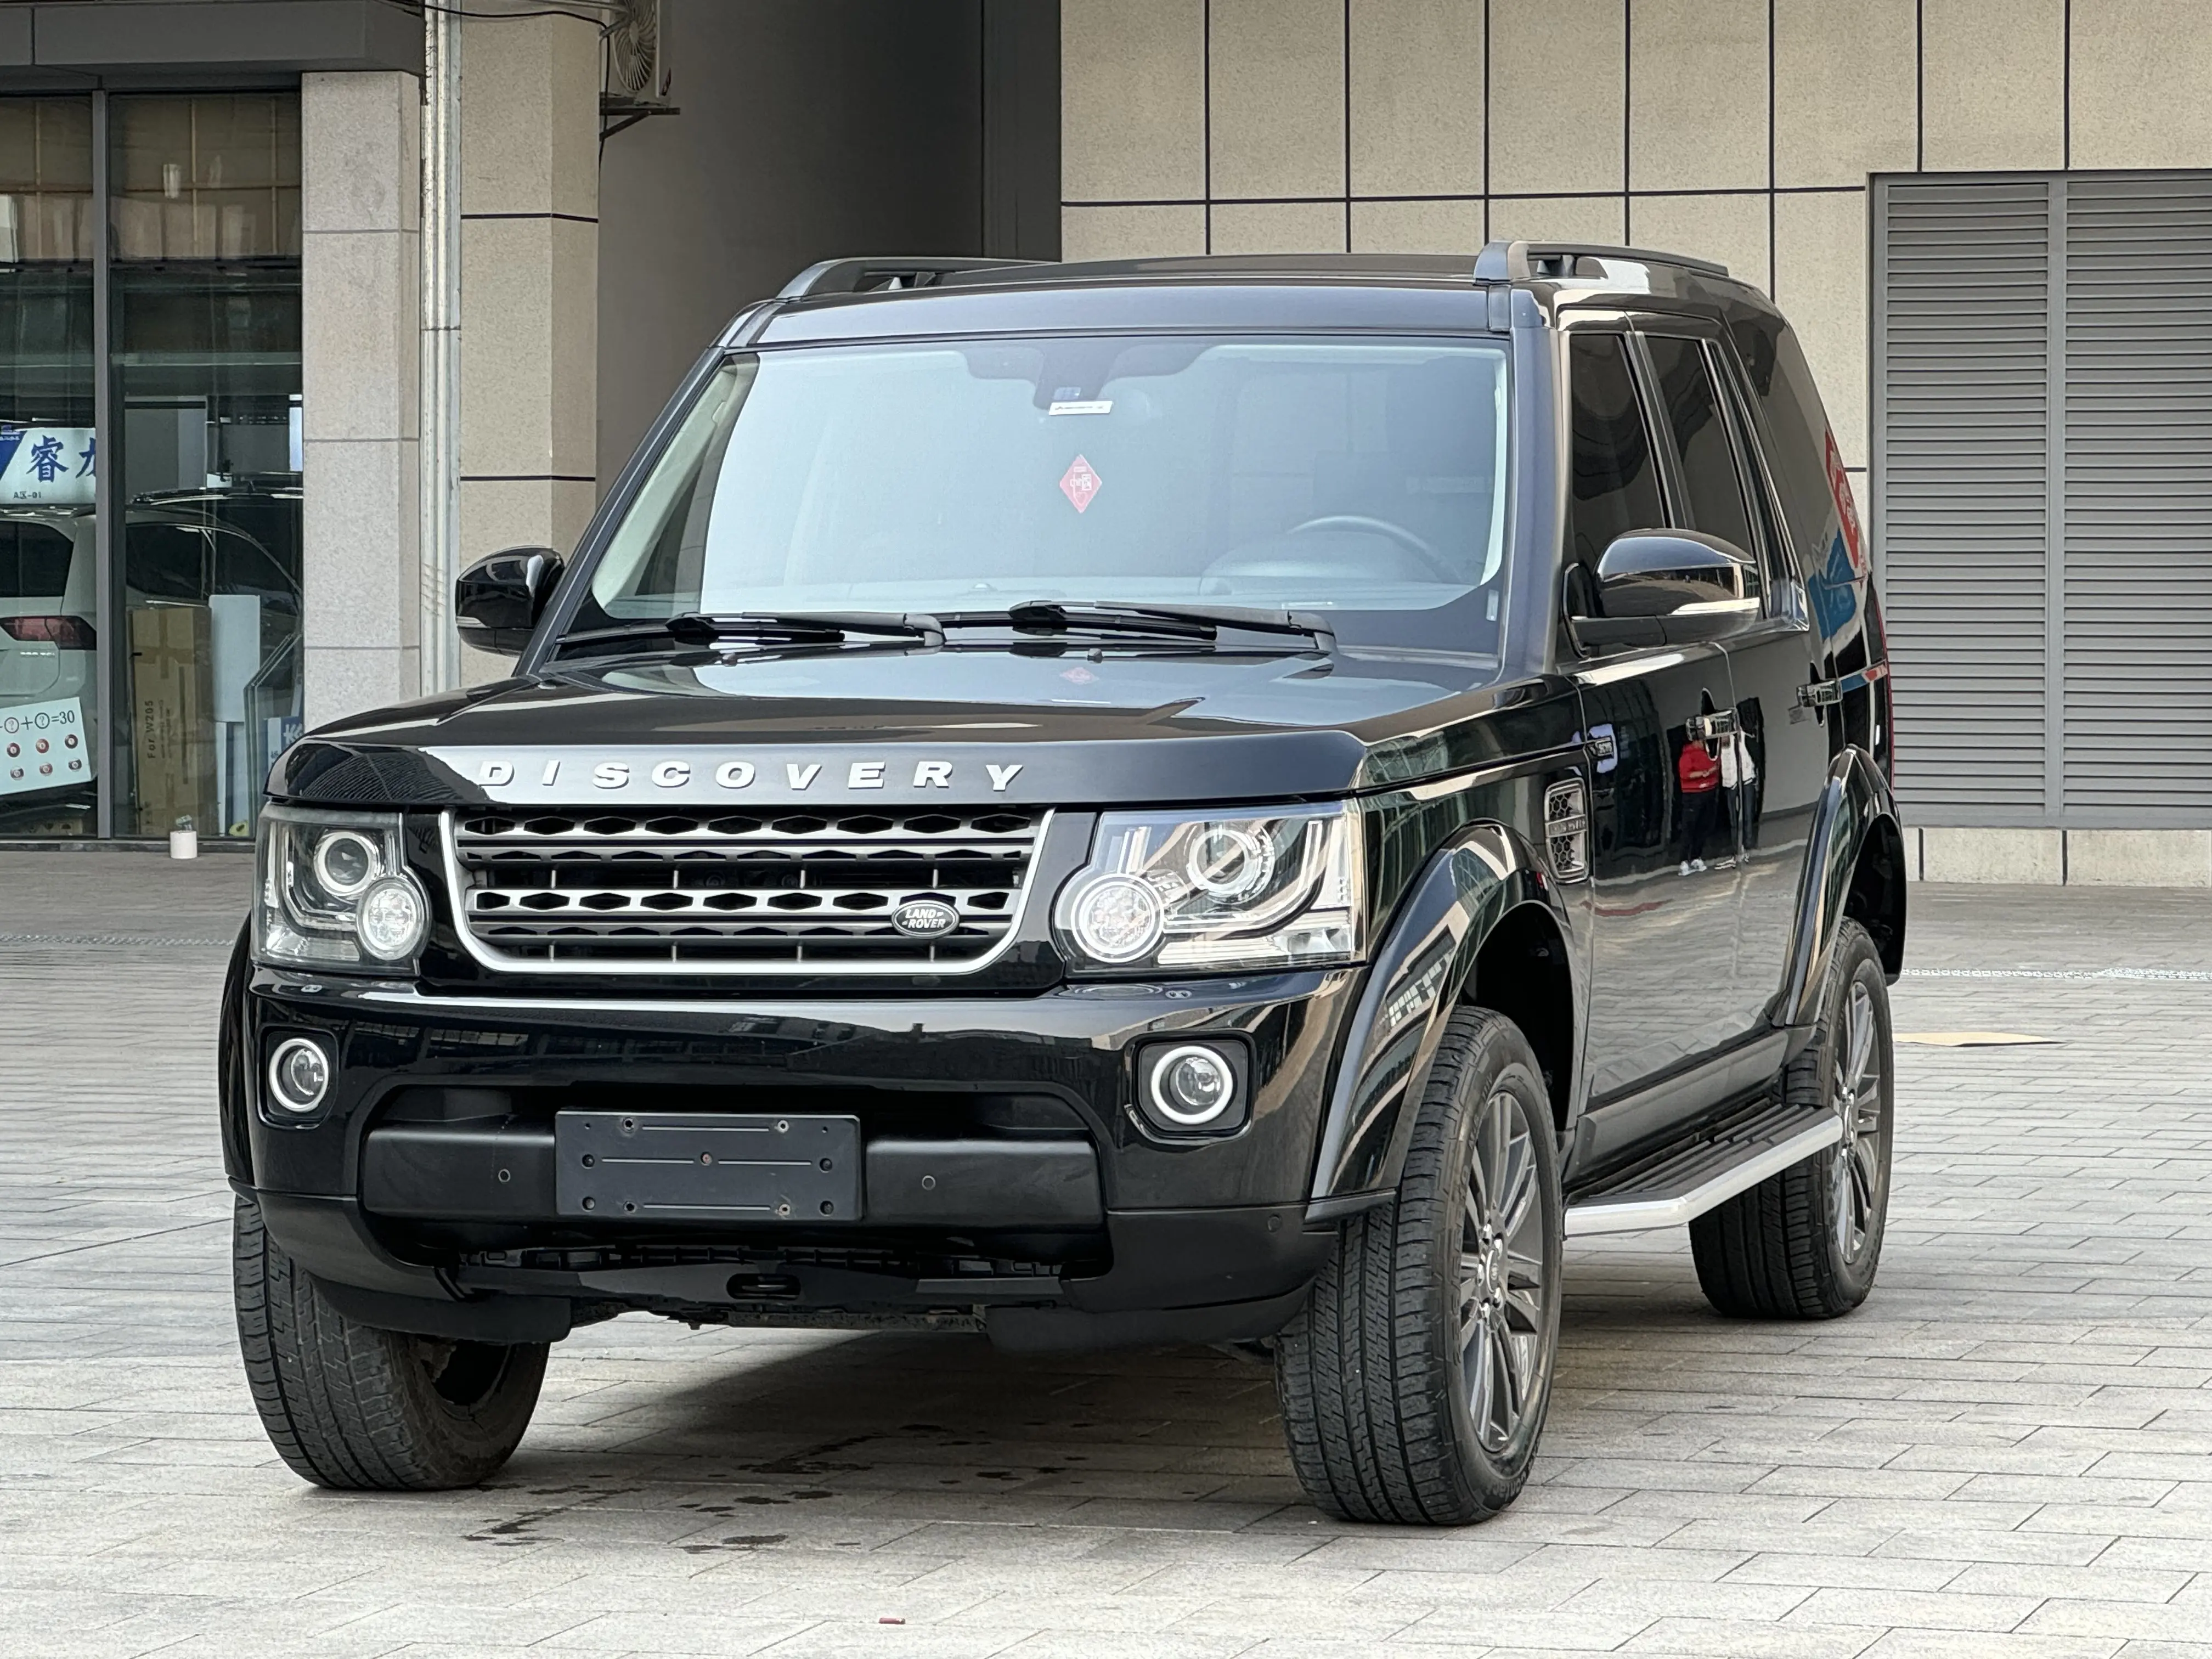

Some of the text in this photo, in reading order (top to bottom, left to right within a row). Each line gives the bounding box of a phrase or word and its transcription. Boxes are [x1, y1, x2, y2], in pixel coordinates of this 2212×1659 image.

[144, 700, 156, 759] For W205
[478, 759, 1024, 792] DISCOVERY
[905, 909, 937, 918] LAND
[907, 918, 946, 929] ROVER
